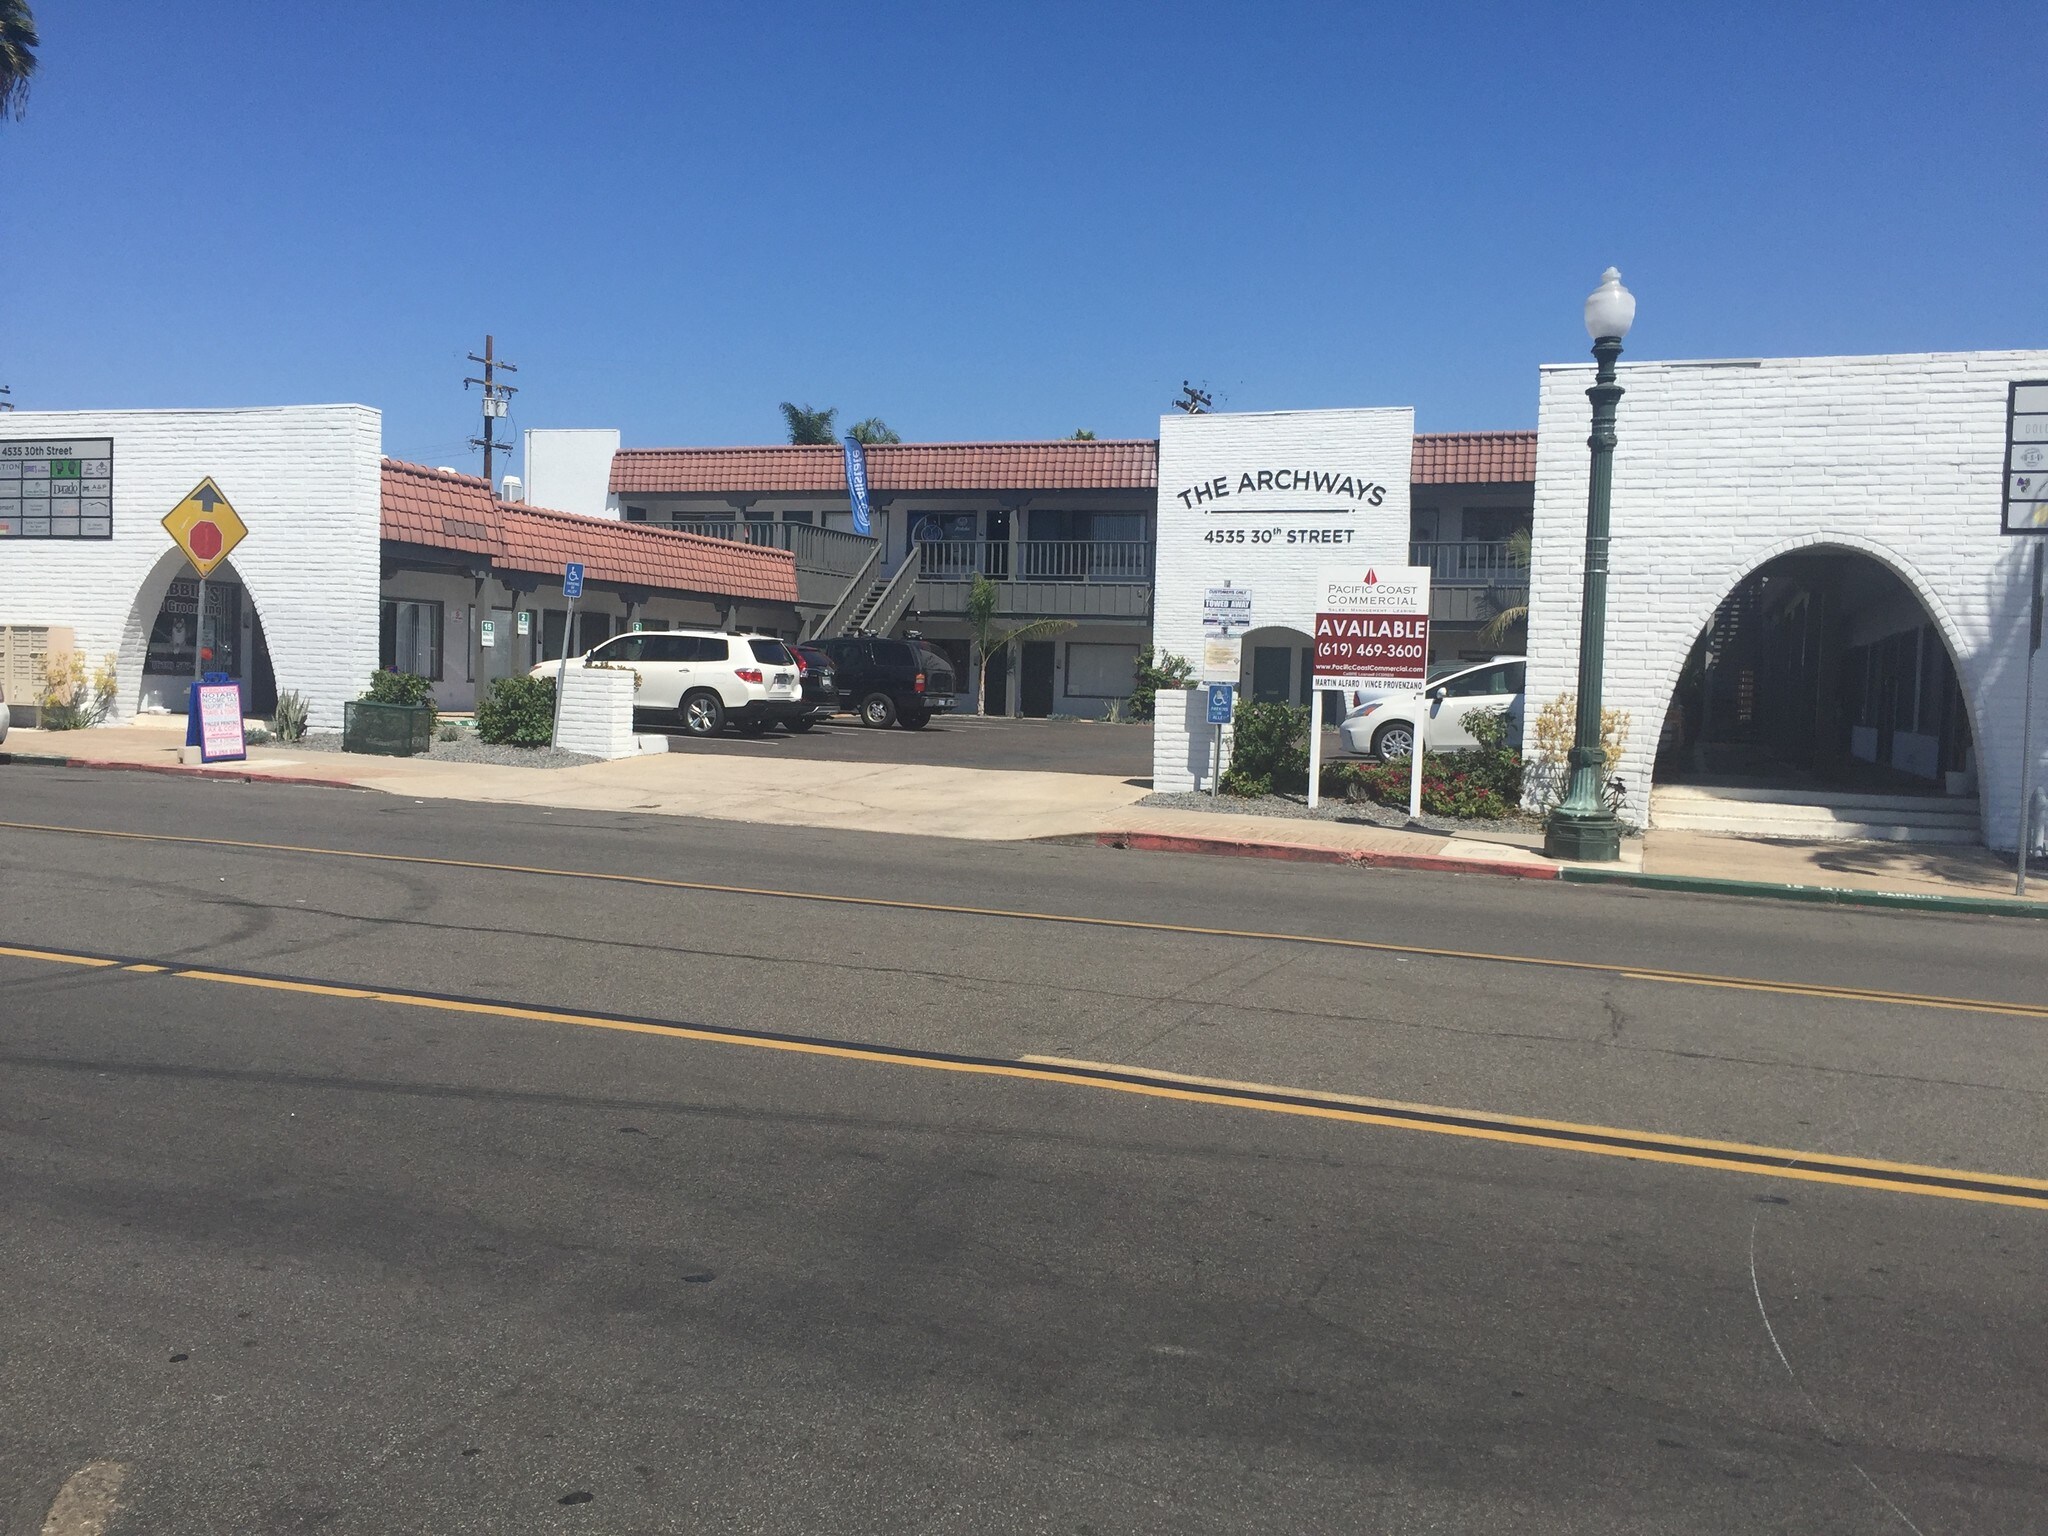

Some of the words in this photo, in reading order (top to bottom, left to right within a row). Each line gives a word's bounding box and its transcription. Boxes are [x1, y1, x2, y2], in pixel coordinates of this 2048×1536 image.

[2, 447, 23, 456] 4535
[24, 446, 44, 456] 30th
[46, 446, 73, 455] Street
[1177, 476, 1230, 510] THE
[1237, 469, 1387, 507] ARCHWAYS
[1204, 530, 1246, 544] 4535
[1251, 527, 1282, 544] 30th
[1286, 529, 1356, 544] STREET
[1328, 584, 1373, 594] PACIFIC
[1376, 584, 1418, 594] COAST
[1205, 600, 1229, 608] TOWED
[1327, 595, 1418, 605] COMMERCIAL
[168, 600, 222, 616] Grooing
[484, 623, 492, 631] 15
[1317, 619, 1426, 639] AVAILABLE
[1318, 643, 1353, 658] (619)
[1356, 643, 1422, 658] 469-3600
[1315, 663, 1423, 673] www.PacificCoastCommercial.com
[1315, 678, 1337, 686] MARTIN
[1338, 679, 1360, 688] ALFARO
[1364, 680, 1381, 689] VINCE
[1383, 680, 1422, 690] PROVENZANO
